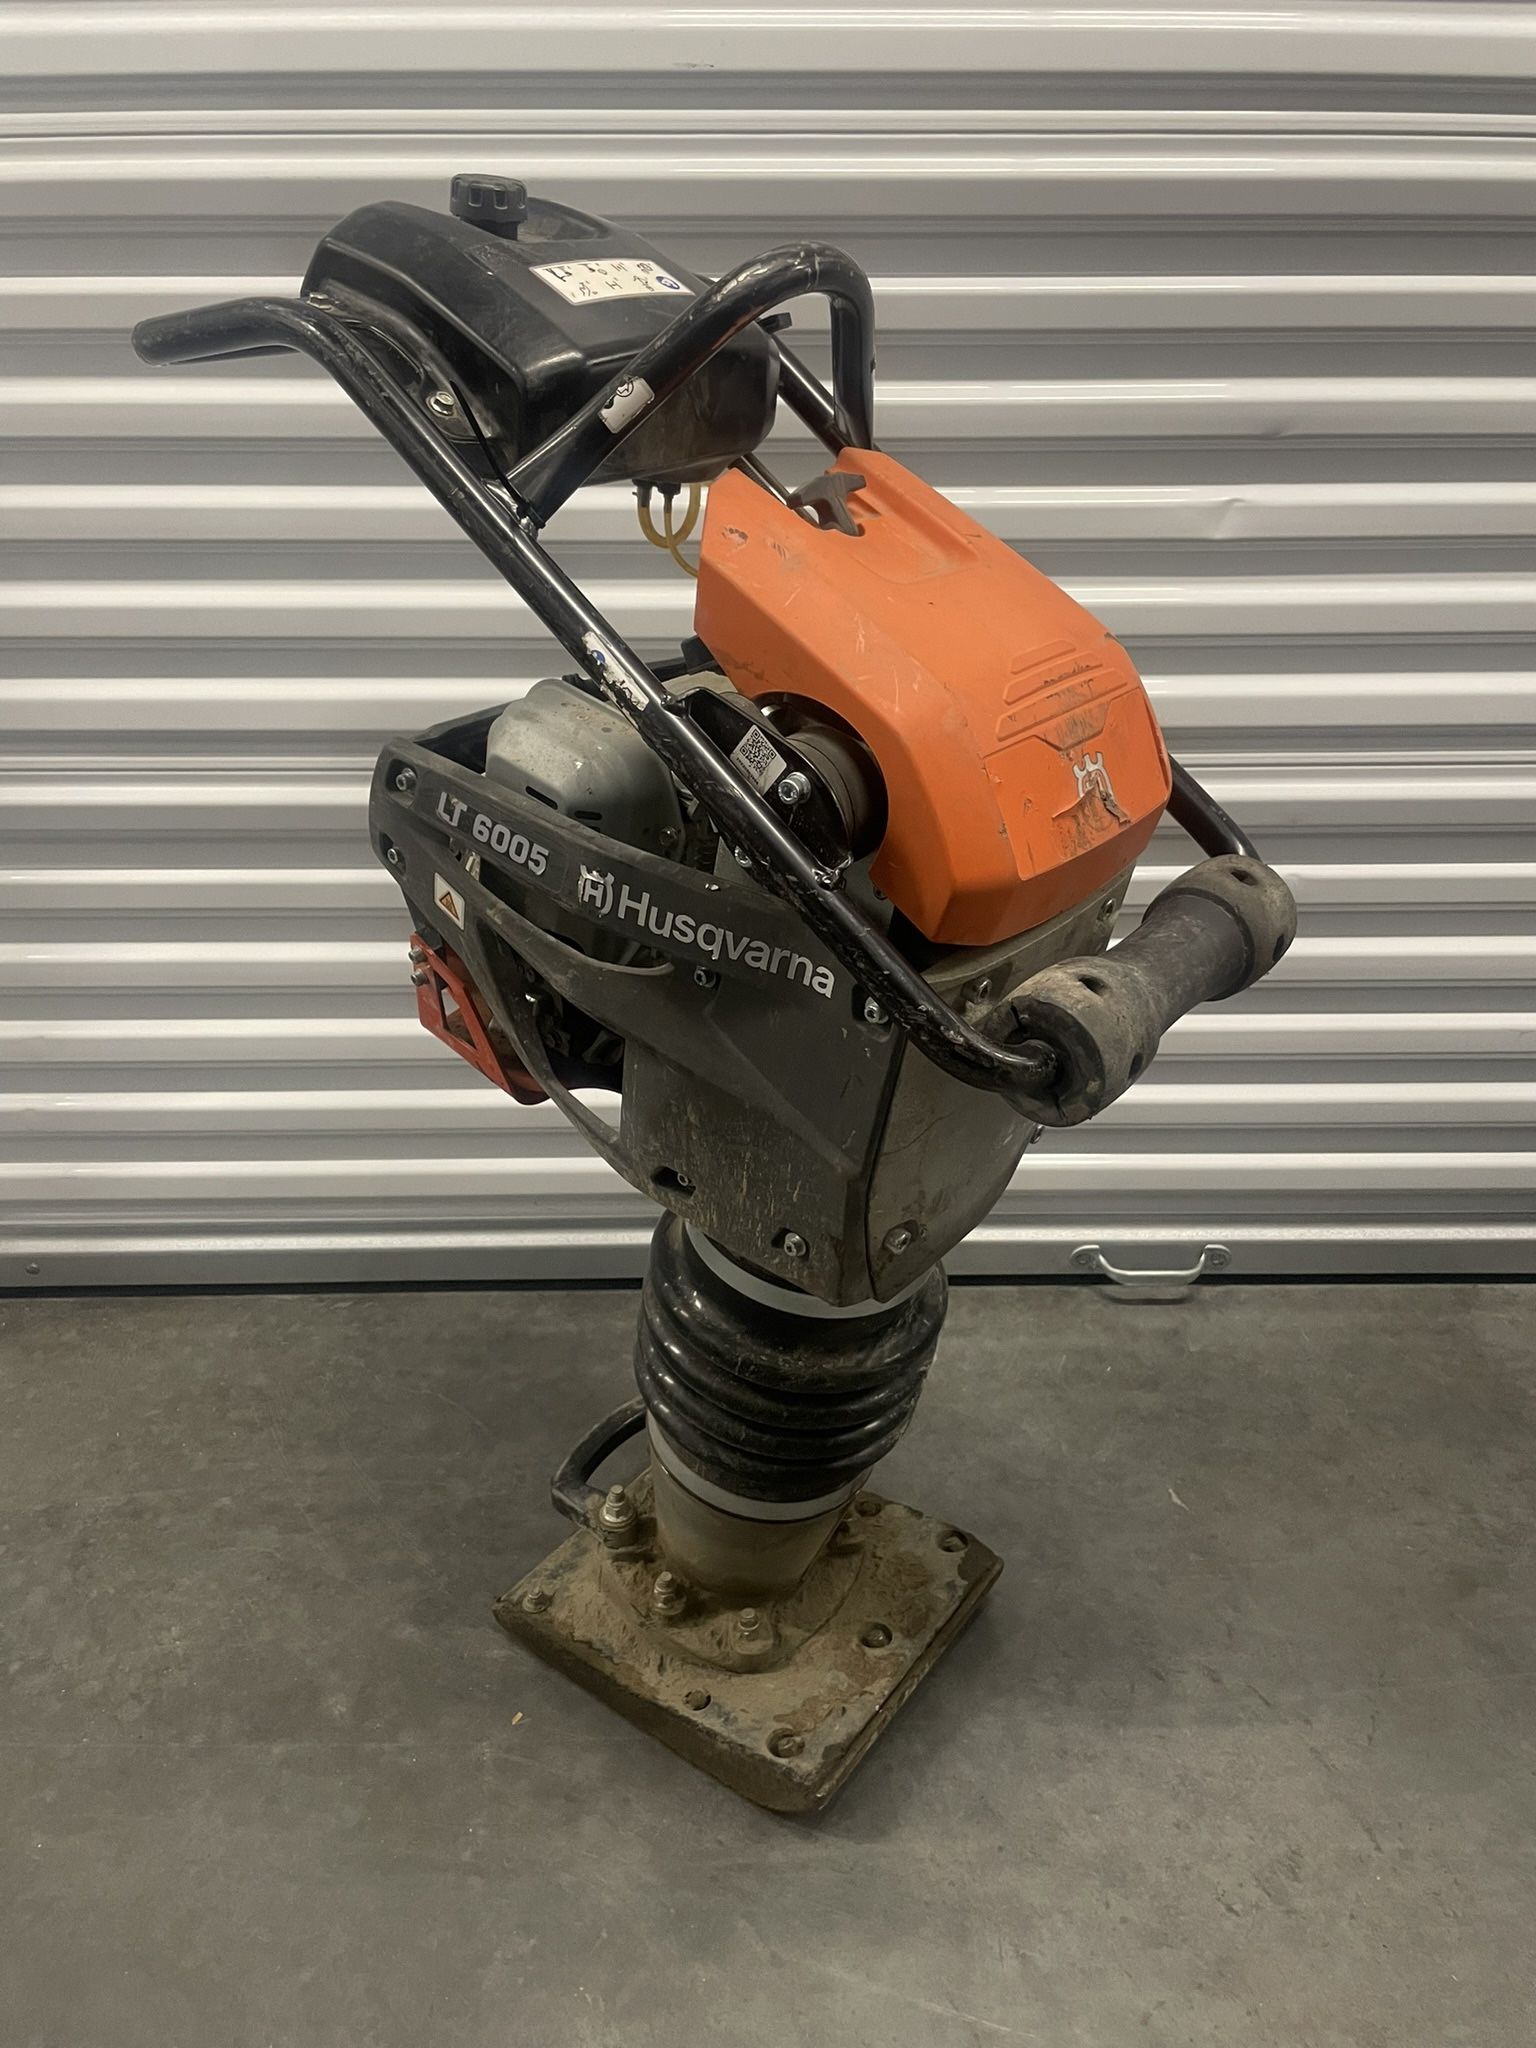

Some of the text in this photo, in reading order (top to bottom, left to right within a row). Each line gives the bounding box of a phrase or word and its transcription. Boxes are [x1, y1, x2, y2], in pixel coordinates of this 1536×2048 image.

[437, 791, 549, 876] LT 6005
[617, 884, 835, 998] Husqvarna
